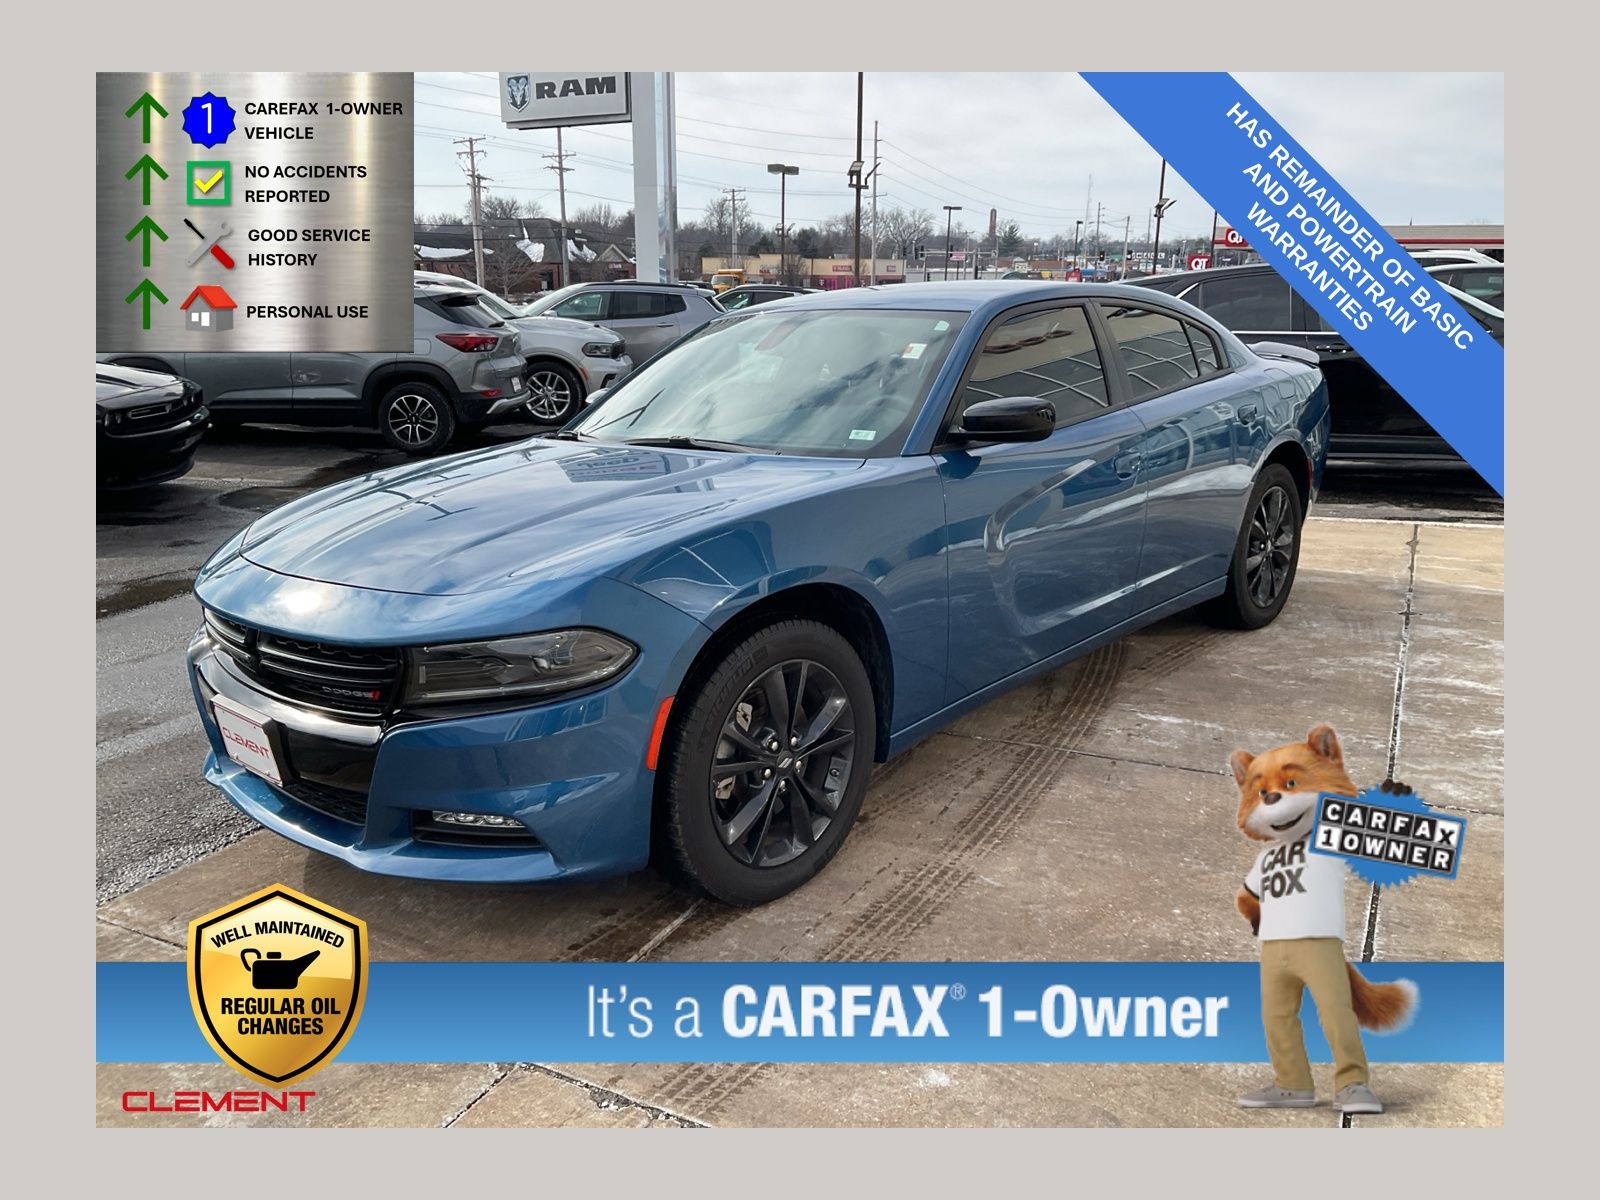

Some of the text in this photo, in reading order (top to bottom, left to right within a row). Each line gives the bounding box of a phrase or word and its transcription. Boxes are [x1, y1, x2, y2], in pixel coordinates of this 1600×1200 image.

[535, 76, 616, 99] RAM
[1191, 258, 1208, 270] QT
[321, 686, 374, 698] DODGE
[222, 728, 269, 757] CLEMENT
